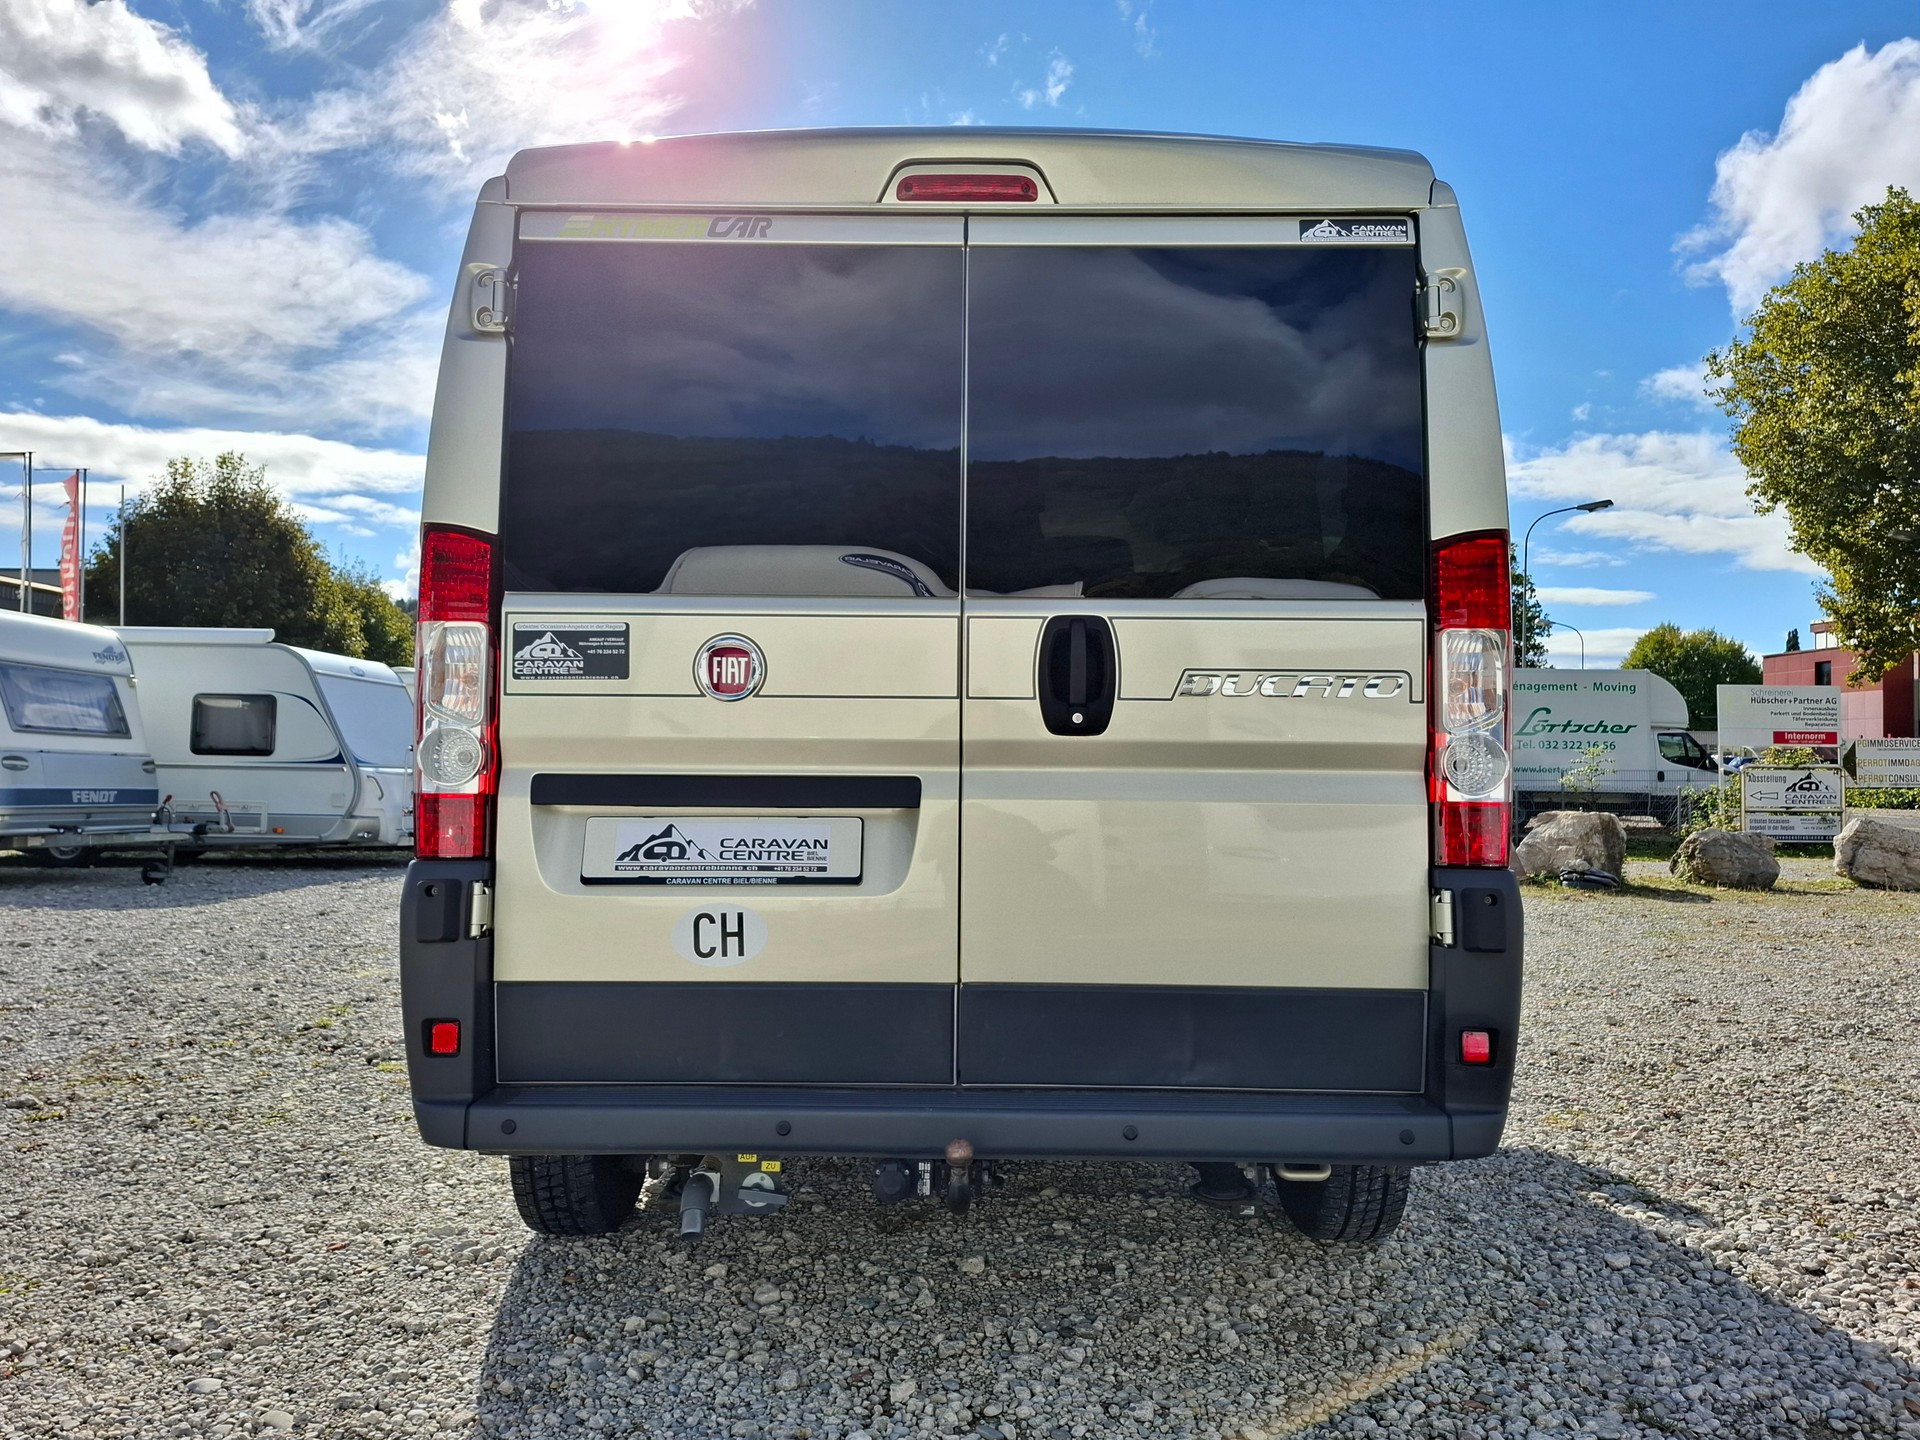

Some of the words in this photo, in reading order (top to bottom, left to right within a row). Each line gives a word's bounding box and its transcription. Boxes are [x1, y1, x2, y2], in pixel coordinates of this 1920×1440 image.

[712, 656, 748, 684] FIAT
[1178, 674, 1404, 698] DUCATO
[1592, 682, 1636, 694] Moving
[1750, 688, 1794, 696] Schreinerei
[1785, 732, 1826, 740] Internorm
[1517, 740, 1535, 749] Tel.
[1539, 740, 1558, 749] 032
[1563, 740, 1582, 750] 322
[1586, 741, 1599, 750] 16
[1602, 741, 1616, 750] 56
[1748, 774, 1787, 783] Ausstellung
[1859, 774, 1920, 783] PERROTCONSUL
[72, 791, 117, 803] FENDT
[720, 838, 828, 850] CARAVAN
[719, 850, 804, 861] CENTRE
[693, 912, 745, 958] CH
